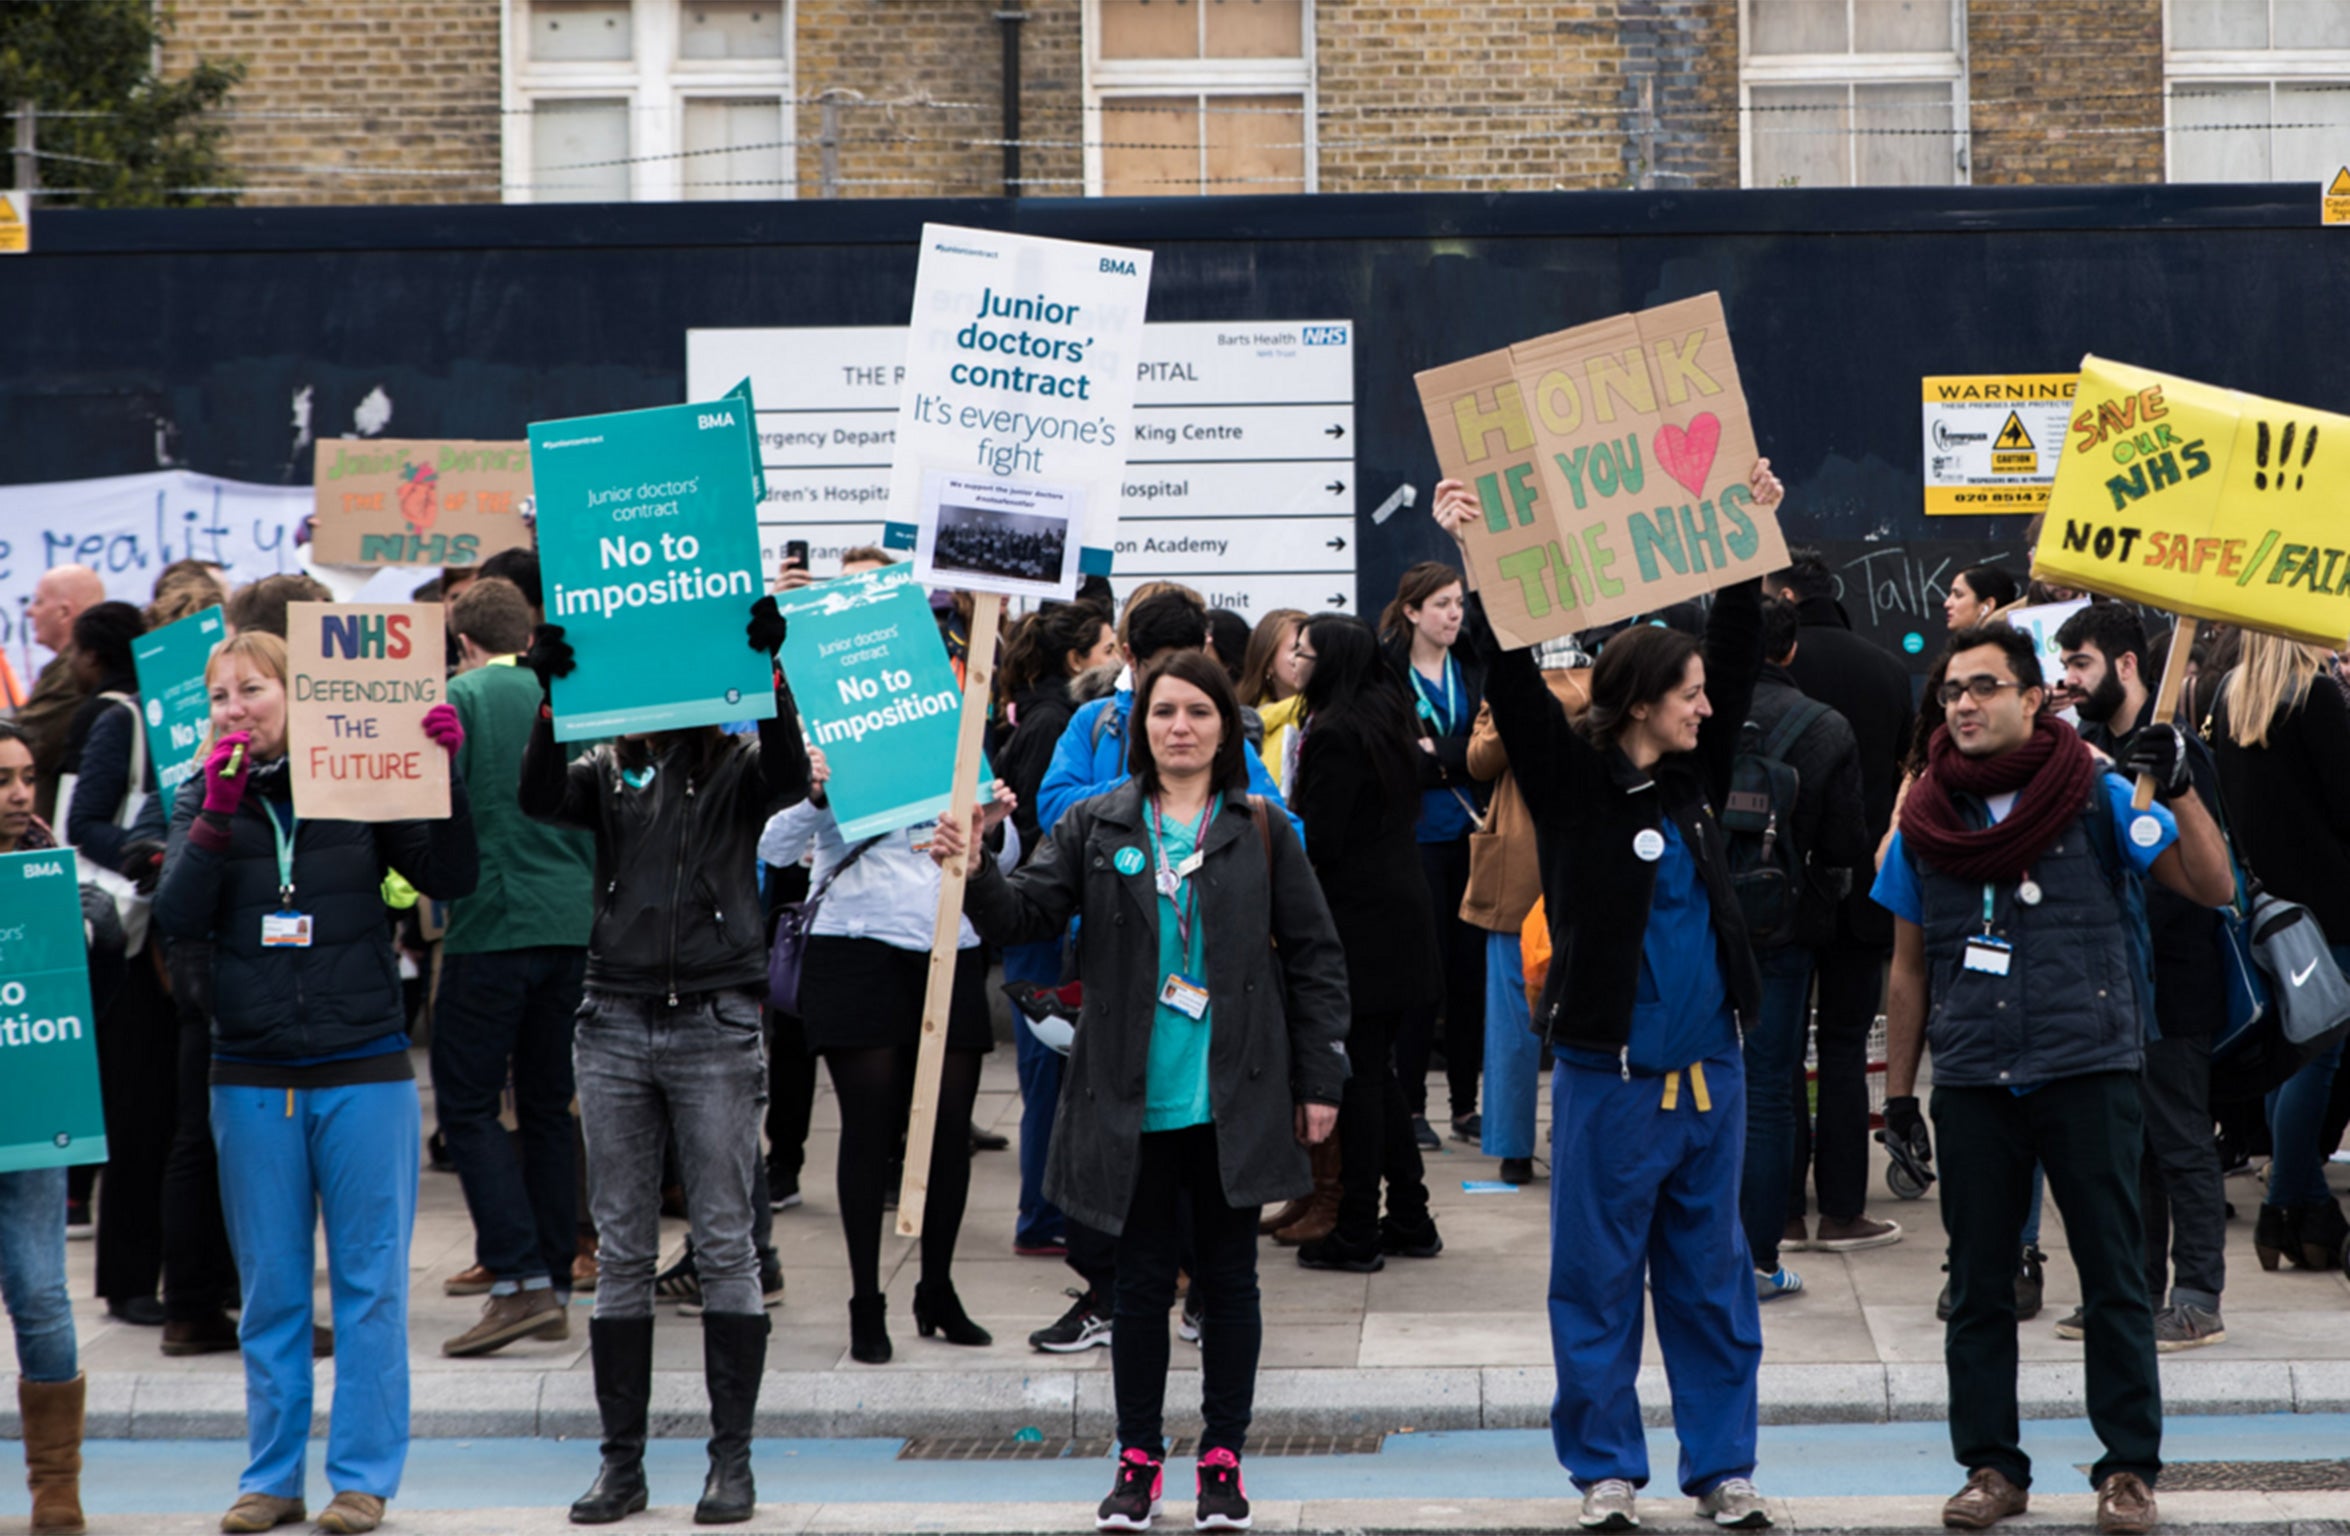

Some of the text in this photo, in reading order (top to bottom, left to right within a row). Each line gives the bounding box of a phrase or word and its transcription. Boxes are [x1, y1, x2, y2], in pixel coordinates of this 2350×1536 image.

[1099, 258, 1137, 276] BMA
[977, 287, 1080, 325] Junior
[957, 322, 1094, 363] doctors'
[1218, 328, 1346, 346] Barts Health NHS
[843, 366, 887, 386] THE
[1137, 362, 1198, 382] PITAL
[950, 363, 1091, 400] contract
[1451, 327, 1724, 465] HONK
[1938, 383, 2077, 399] WARNING
[698, 412, 735, 430] BMA
[914, 393, 1117, 446] It's everyone's
[1134, 424, 1243, 444] King Centre
[2073, 384, 2169, 454] SAVE
[833, 429, 896, 448] Depart
[2112, 423, 2184, 465] OUR
[977, 437, 1044, 477] fight
[1996, 454, 2030, 464] CAUTION
[1475, 432, 1645, 534] IF YOU
[2105, 438, 2212, 512] NHS
[588, 476, 700, 508] Junior doctors'
[1954, 494, 1988, 502] 020
[1992, 493, 2032, 502] 8514
[612, 501, 679, 522] contract
[360, 533, 480, 564] NHS
[600, 532, 700, 570] No to
[1143, 537, 1228, 556] Academy
[1497, 483, 1759, 619] THE NHS
[2062, 519, 2141, 563] NOT
[553, 567, 752, 619] imposition
[1210, 593, 1250, 608] Unit
[321, 614, 411, 660] NHS
[818, 624, 899, 658] Junior doctors'
[841, 644, 890, 666] contract
[296, 674, 436, 704] DEFENDING
[837, 669, 912, 704] No to
[326, 714, 379, 738] THE
[812, 690, 959, 745] imposition
[170, 723, 195, 750] No
[310, 746, 422, 780] FUTURE
[23, 862, 63, 879] BMA
[0, 981, 26, 1006] o
